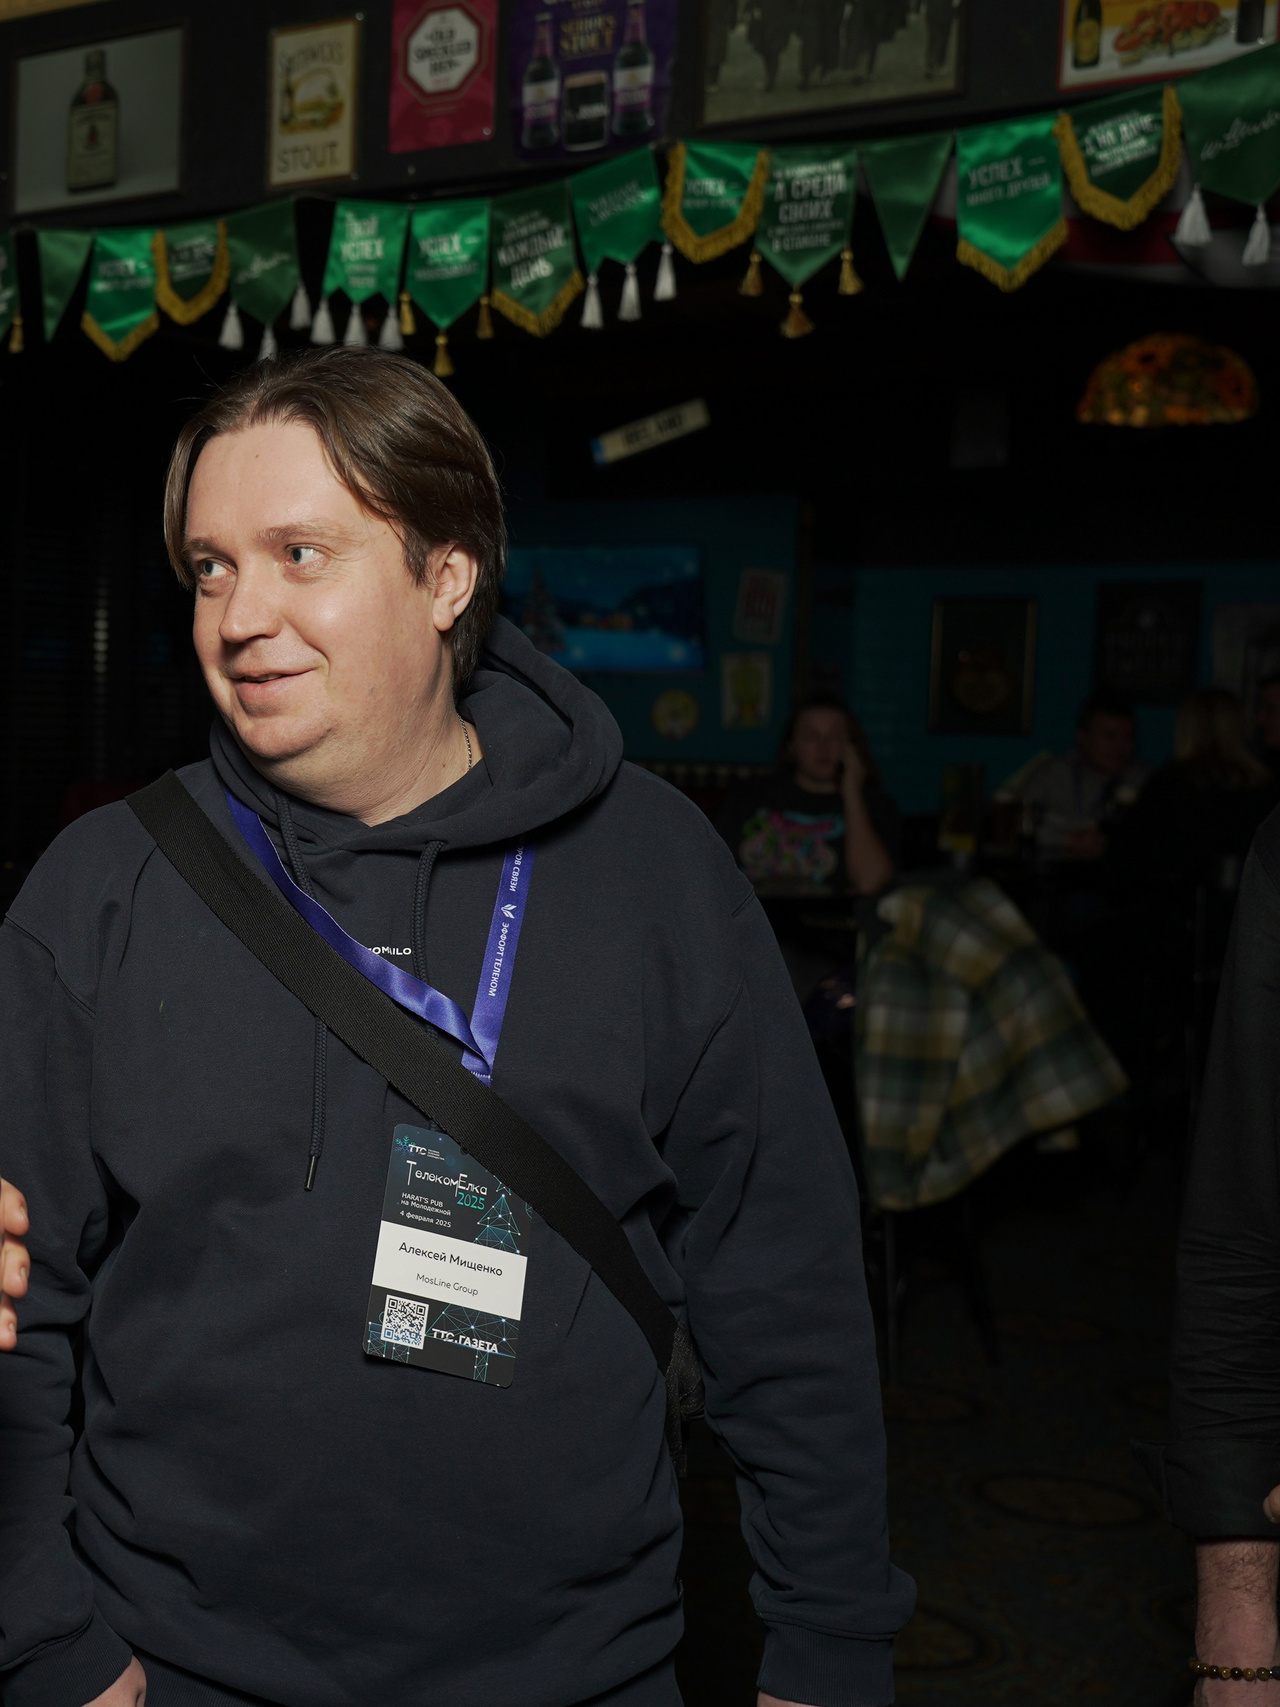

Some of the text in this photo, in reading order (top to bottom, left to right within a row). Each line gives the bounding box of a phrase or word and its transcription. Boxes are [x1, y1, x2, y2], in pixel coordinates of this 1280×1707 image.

[968, 155, 1024, 190] УСПЕХ
[791, 173, 846, 200] СРЕДИ
[779, 199, 834, 224] СВОИХ
[509, 866, 520, 892] СВЯЗИ
[488, 922, 509, 997] ЭФФОРТ ТЕЛЕКОМ
[402, 1192, 443, 1208] HARAT'S PUB
[457, 1192, 485, 1210] 2025
[406, 1211, 434, 1223] февраля
[435, 1218, 452, 1228] 2025
[399, 1242, 503, 1276] Алексей Мищенко
[416, 1273, 478, 1297] MosLine Group
